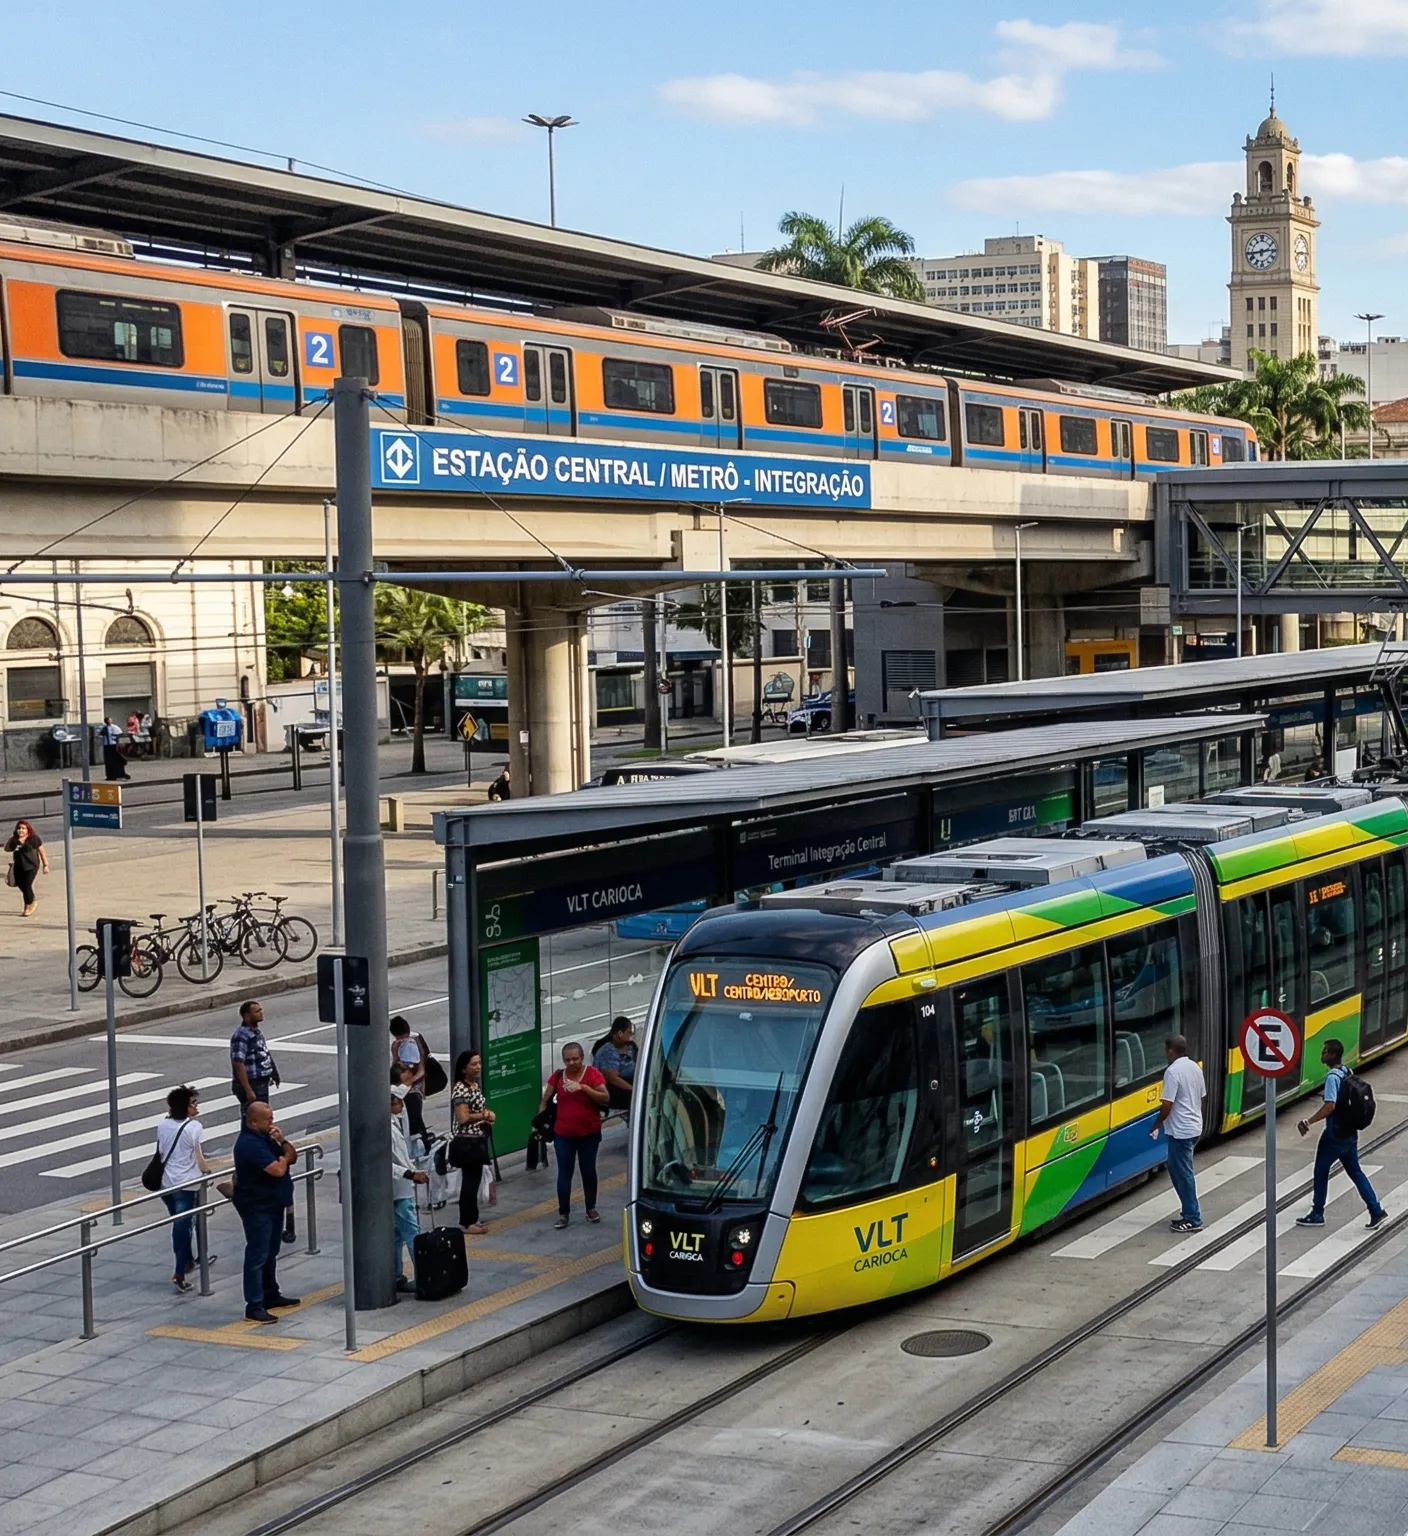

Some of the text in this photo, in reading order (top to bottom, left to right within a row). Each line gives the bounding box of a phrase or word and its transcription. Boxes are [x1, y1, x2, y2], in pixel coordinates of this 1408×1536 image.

[311, 335, 329, 364] 2
[499, 356, 514, 383] 2
[882, 402, 893, 423] 2
[433, 448, 548, 486] ESTAÇÃO
[554, 456, 656, 486] CENTRAL
[671, 461, 739, 491] METRÔ
[754, 469, 864, 501] INTEGRAÇÃO
[768, 848, 808, 870] Terminal
[810, 839, 855, 863] Integração
[567, 883, 643, 913] VLT CARIOCA
[689, 973, 718, 997] VLT
[920, 1004, 935, 1018] 104
[1258, 1024, 1282, 1062] E
[670, 1231, 705, 1251] VLT
[854, 1212, 908, 1253] VLT
[853, 1248, 908, 1272] CARIOCA
